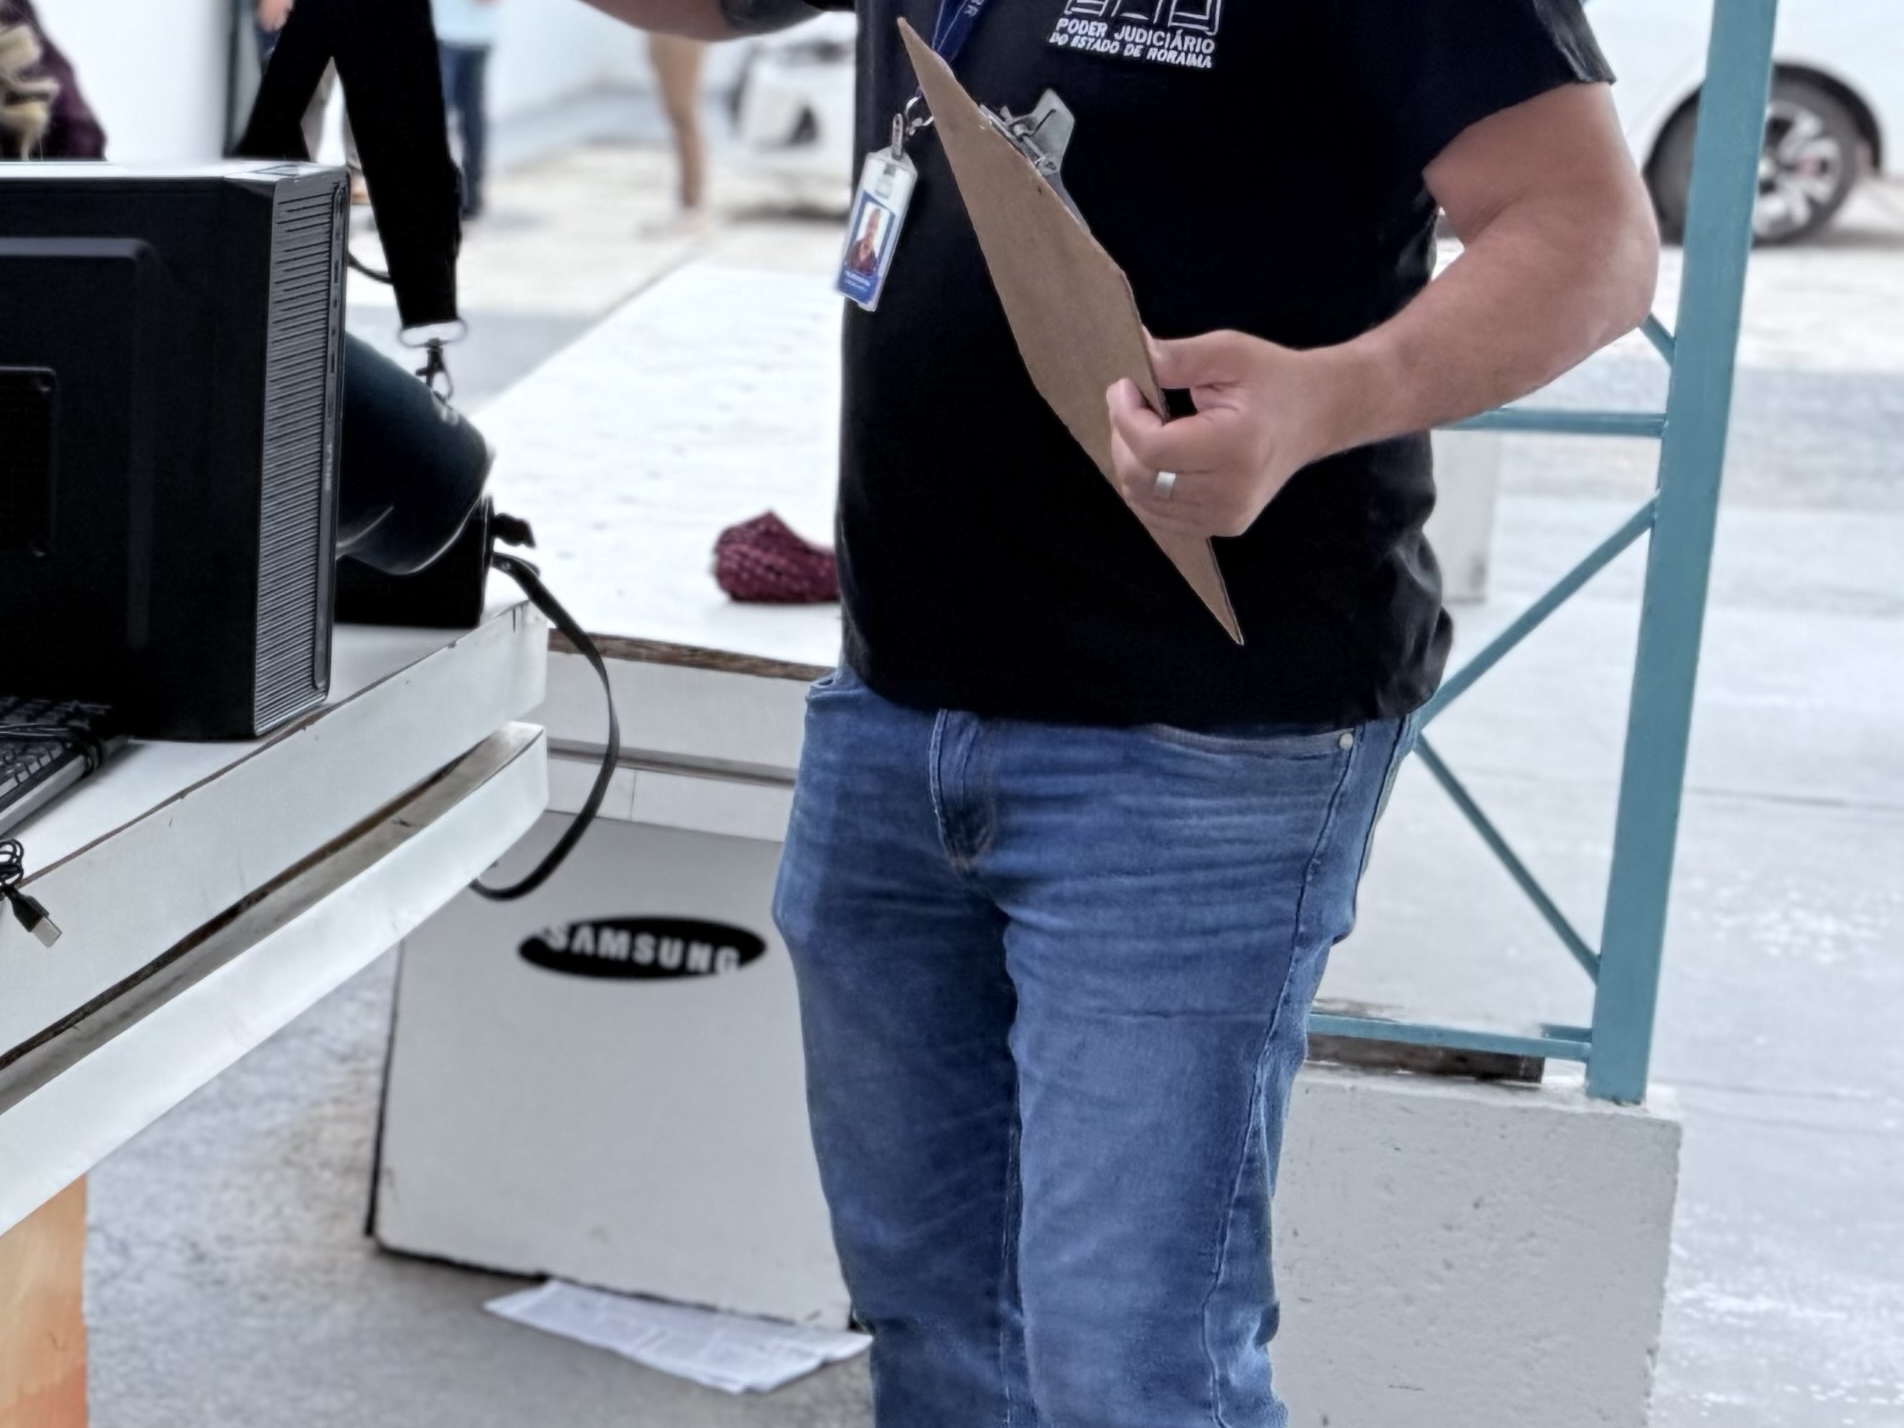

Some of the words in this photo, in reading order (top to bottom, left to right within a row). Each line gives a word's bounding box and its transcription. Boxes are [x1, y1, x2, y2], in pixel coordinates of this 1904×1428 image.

[1049, 32, 1069, 46] DO
[1070, 35, 1120, 54] ESTADO
[1123, 43, 1143, 58] DE
[1146, 47, 1212, 69] RORAIMA
[1056, 18, 1108, 37] PODER
[1114, 26, 1215, 54] JUDICIÁRIO
[544, 924, 741, 973] SAMSUNG
